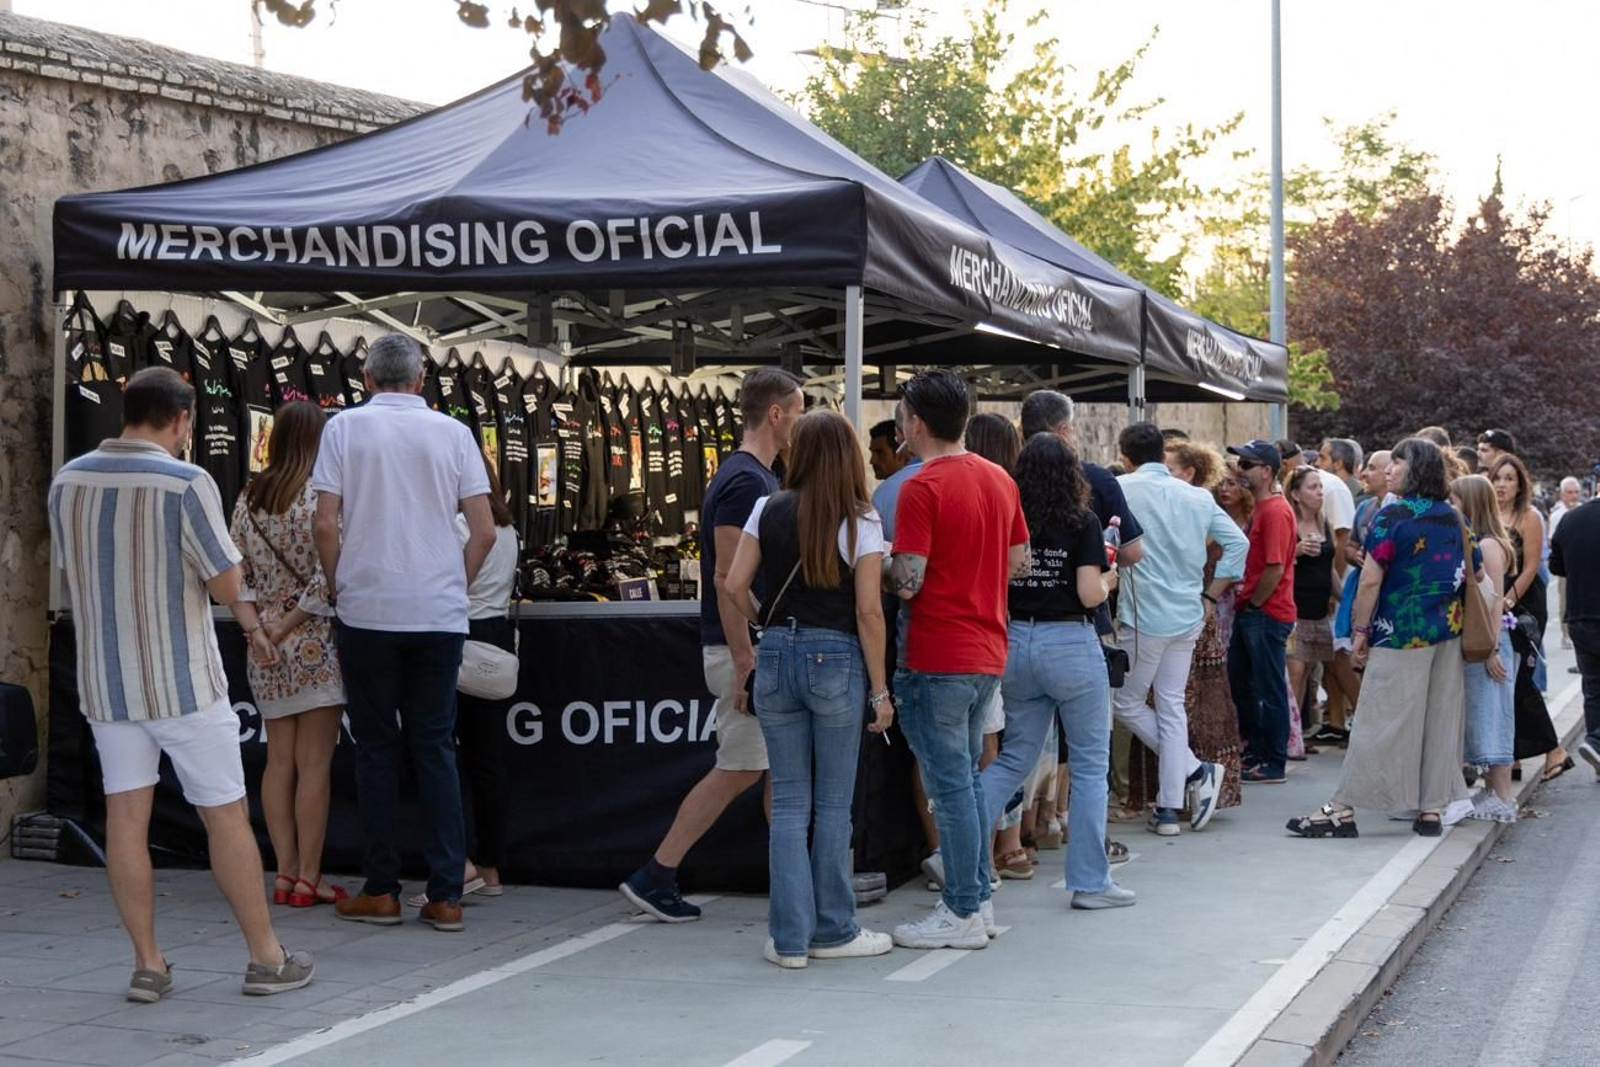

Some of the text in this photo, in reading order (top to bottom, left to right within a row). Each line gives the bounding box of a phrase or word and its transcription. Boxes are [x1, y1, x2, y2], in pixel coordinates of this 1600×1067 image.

[117, 211, 783, 268] MERCHANDISING OFICIAL
[561, 699, 719, 745] OFICIA
